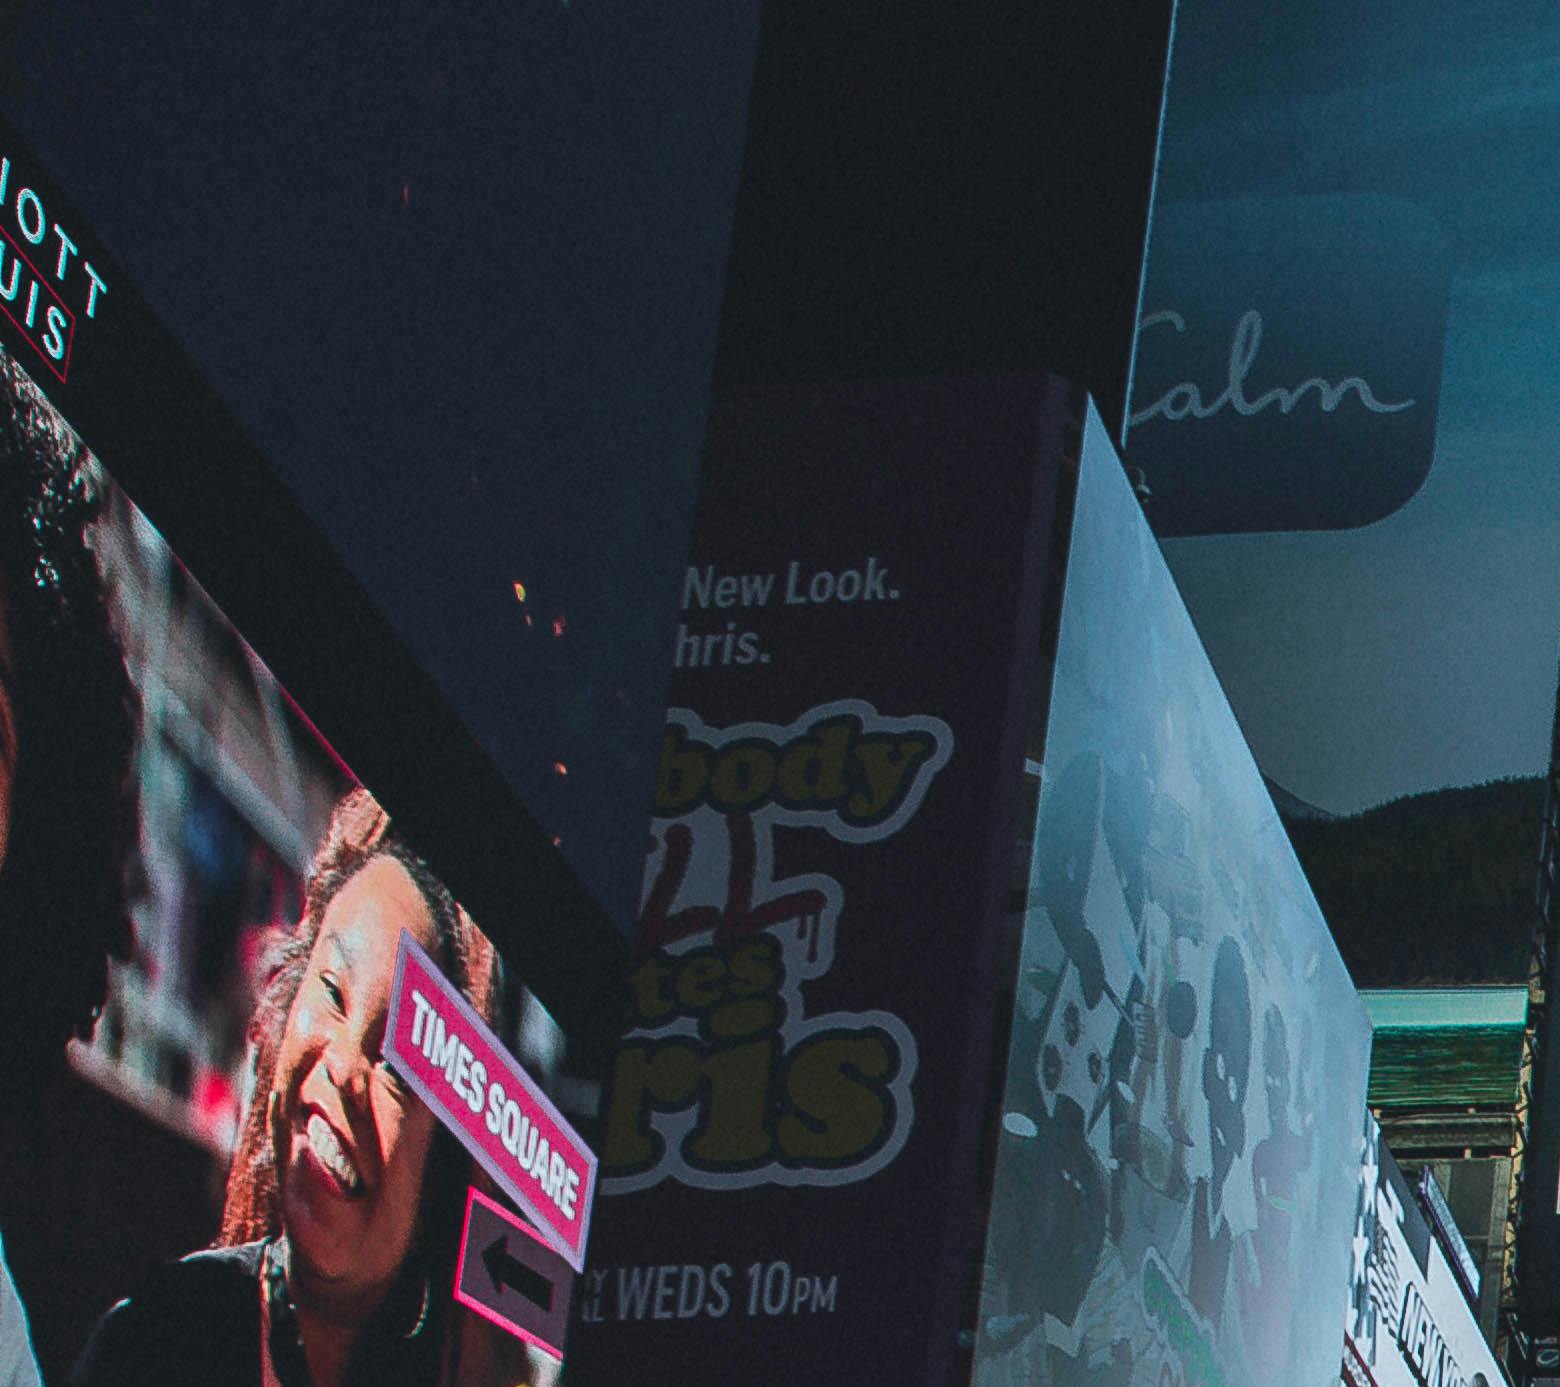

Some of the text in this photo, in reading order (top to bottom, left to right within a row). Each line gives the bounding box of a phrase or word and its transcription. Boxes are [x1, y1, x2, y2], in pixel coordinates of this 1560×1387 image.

[681, 556, 900, 609] New Look.
[409, 989, 580, 1220] TIMES SQUARE
[617, 1263, 733, 1320] WEDS
